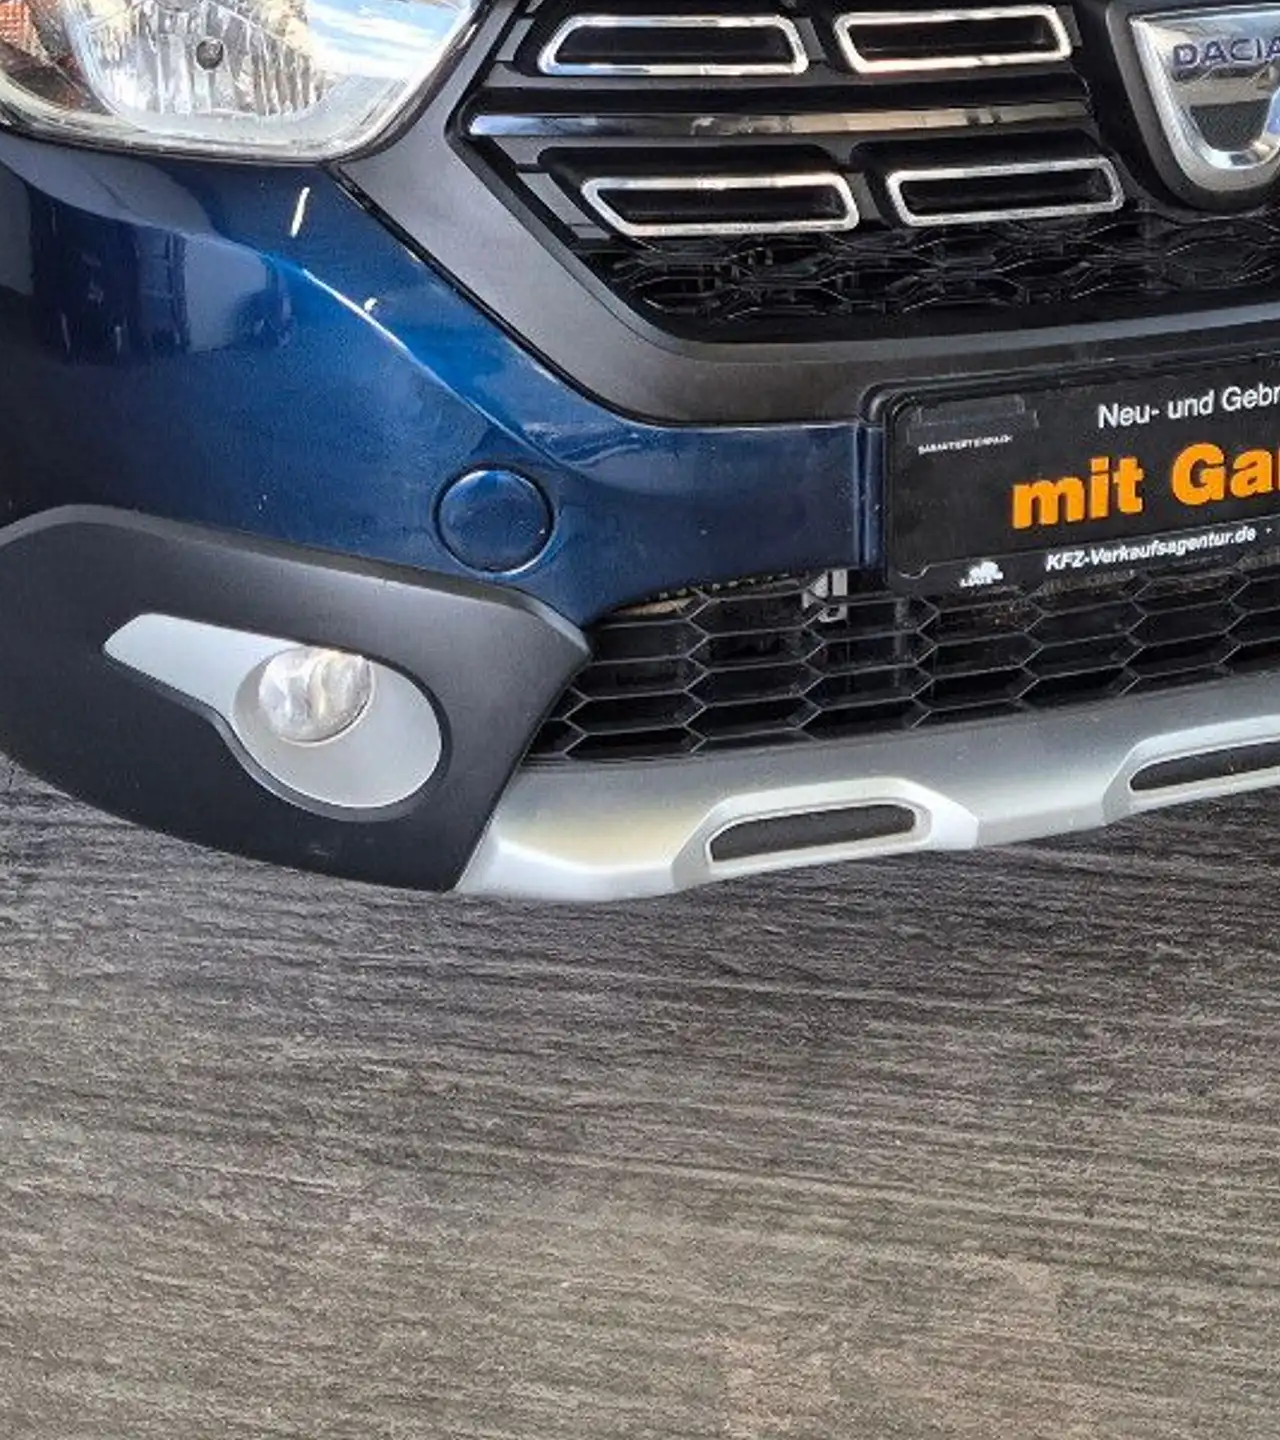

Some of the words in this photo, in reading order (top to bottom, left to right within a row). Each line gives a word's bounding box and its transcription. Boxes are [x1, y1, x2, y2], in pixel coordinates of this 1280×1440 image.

[1097, 400, 1161, 430] Neu-
[1168, 389, 1216, 420] und
[1011, 456, 1145, 530] mit
[1045, 526, 1258, 572] KFZ-Verkaufsagentur.de
